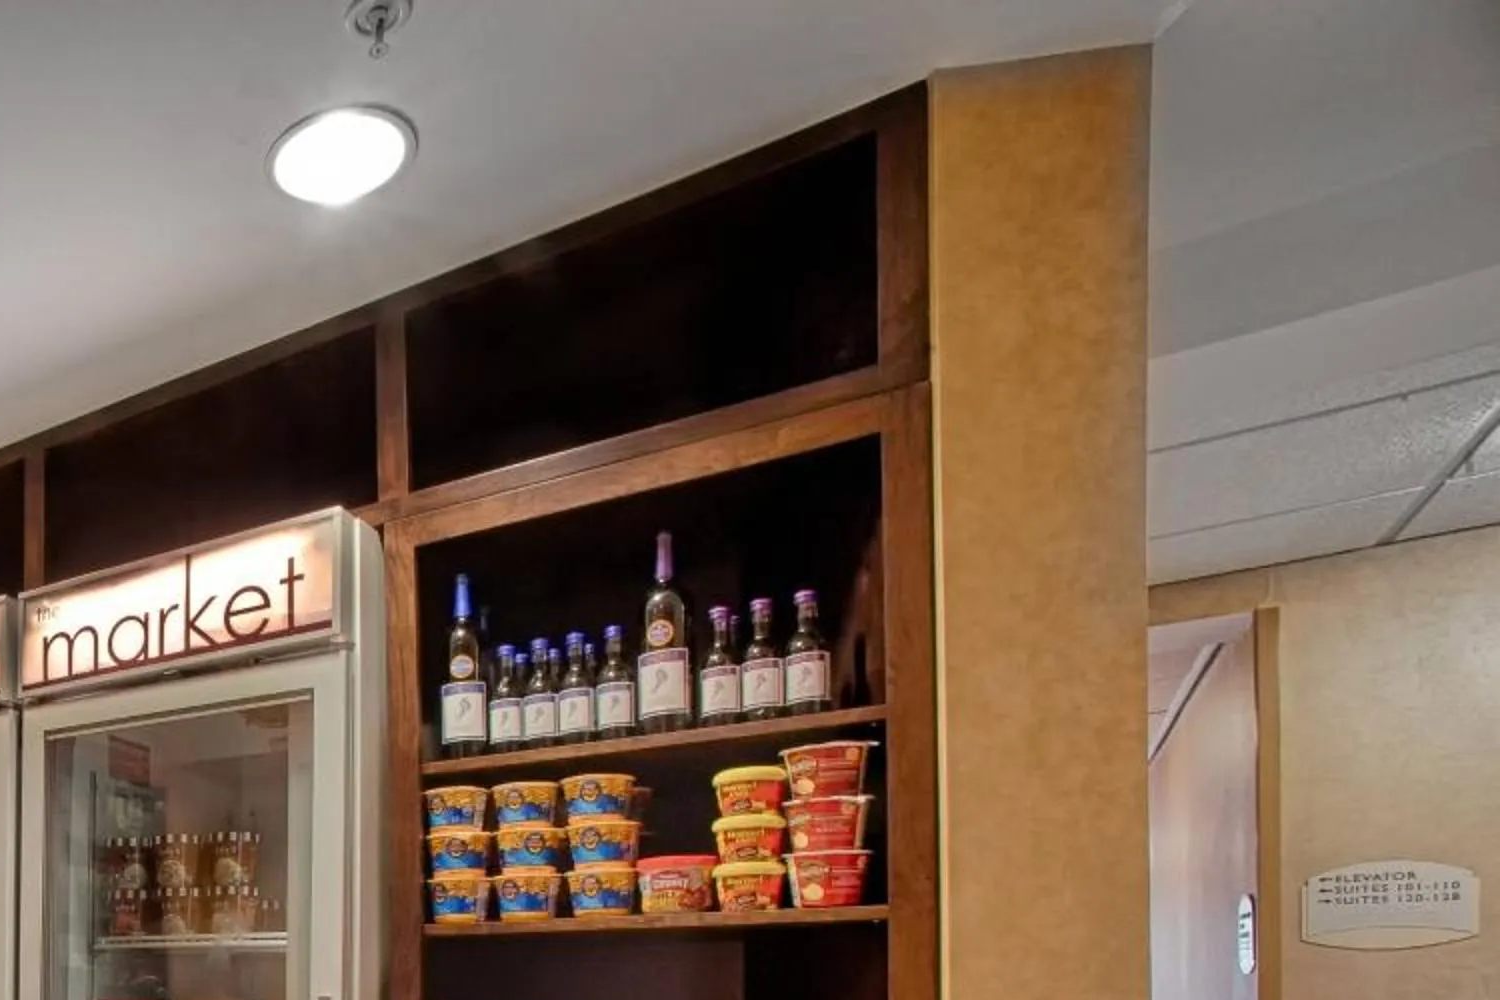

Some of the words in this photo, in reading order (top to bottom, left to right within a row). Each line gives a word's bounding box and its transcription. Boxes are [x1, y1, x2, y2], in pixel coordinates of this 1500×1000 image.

[36, 602, 60, 622] the
[43, 554, 305, 684] market
[1335, 871, 1417, 883] ELEVATOR
[1334, 884, 1389, 895] SUITES
[1334, 895, 1389, 905] SUITES
